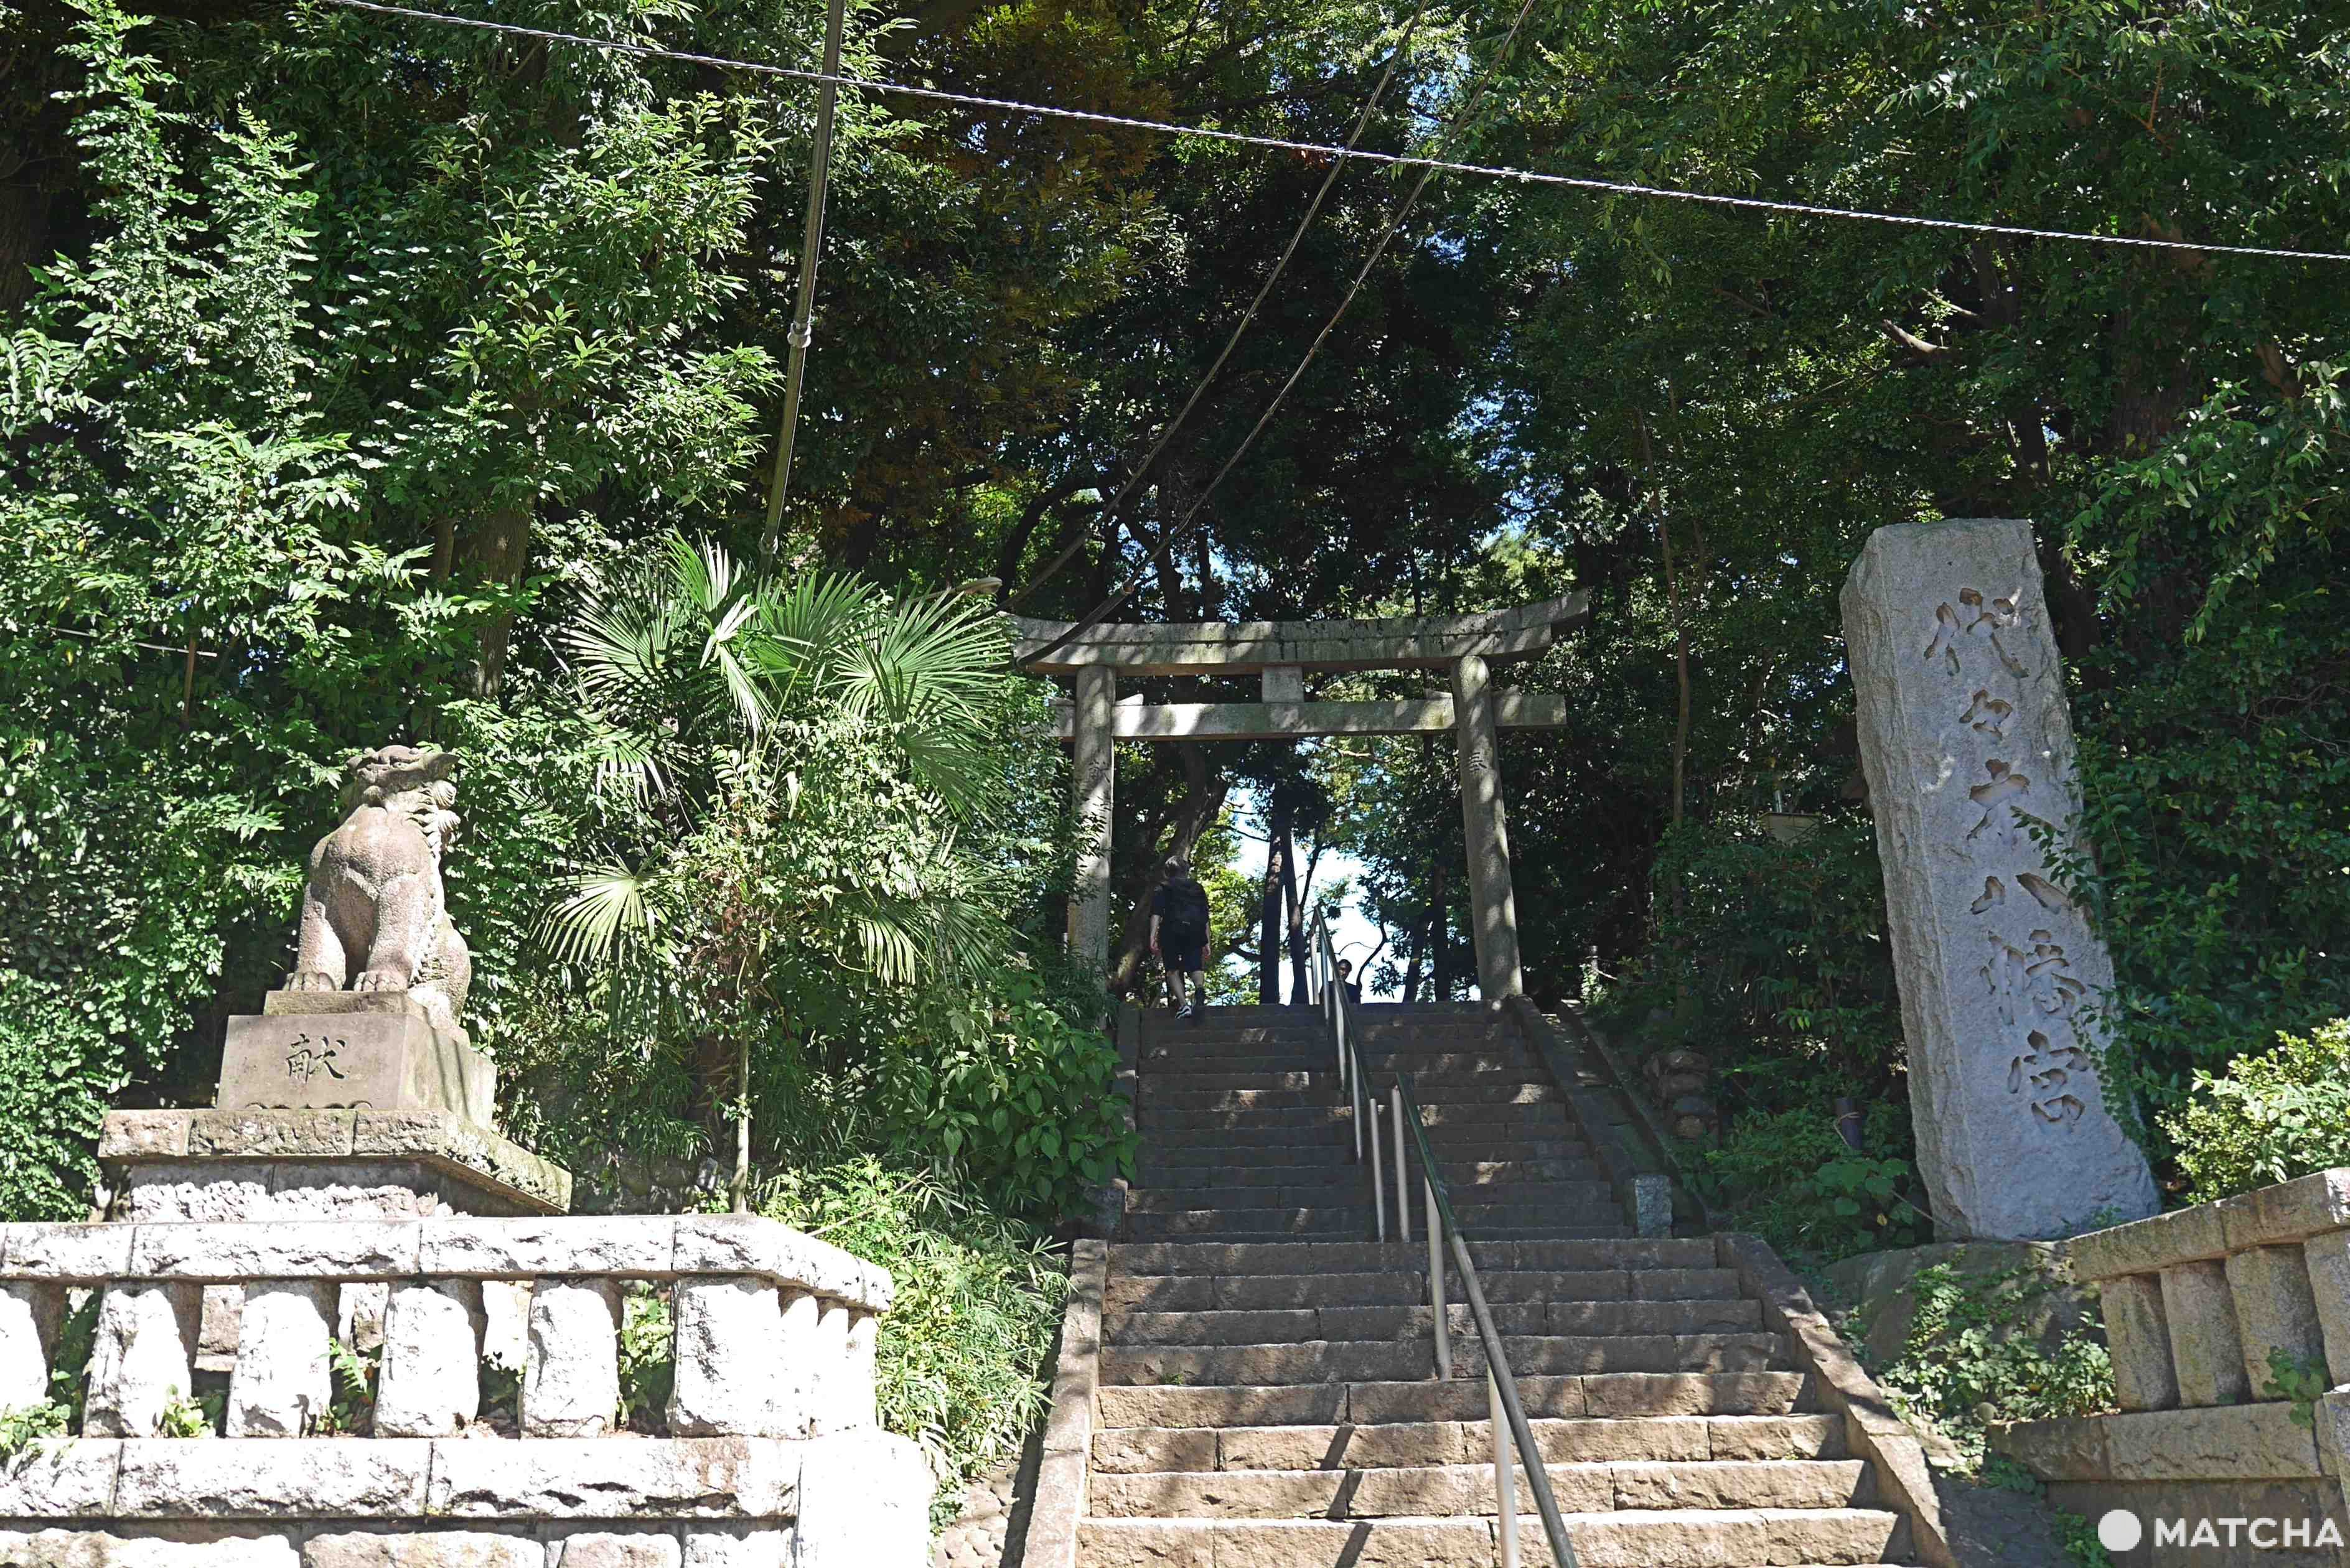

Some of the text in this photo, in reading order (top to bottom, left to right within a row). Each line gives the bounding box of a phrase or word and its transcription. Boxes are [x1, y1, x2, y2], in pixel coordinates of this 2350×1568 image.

[1924, 587, 2091, 1133] 代々木八幡宮
[285, 1034, 346, 1084] 献
